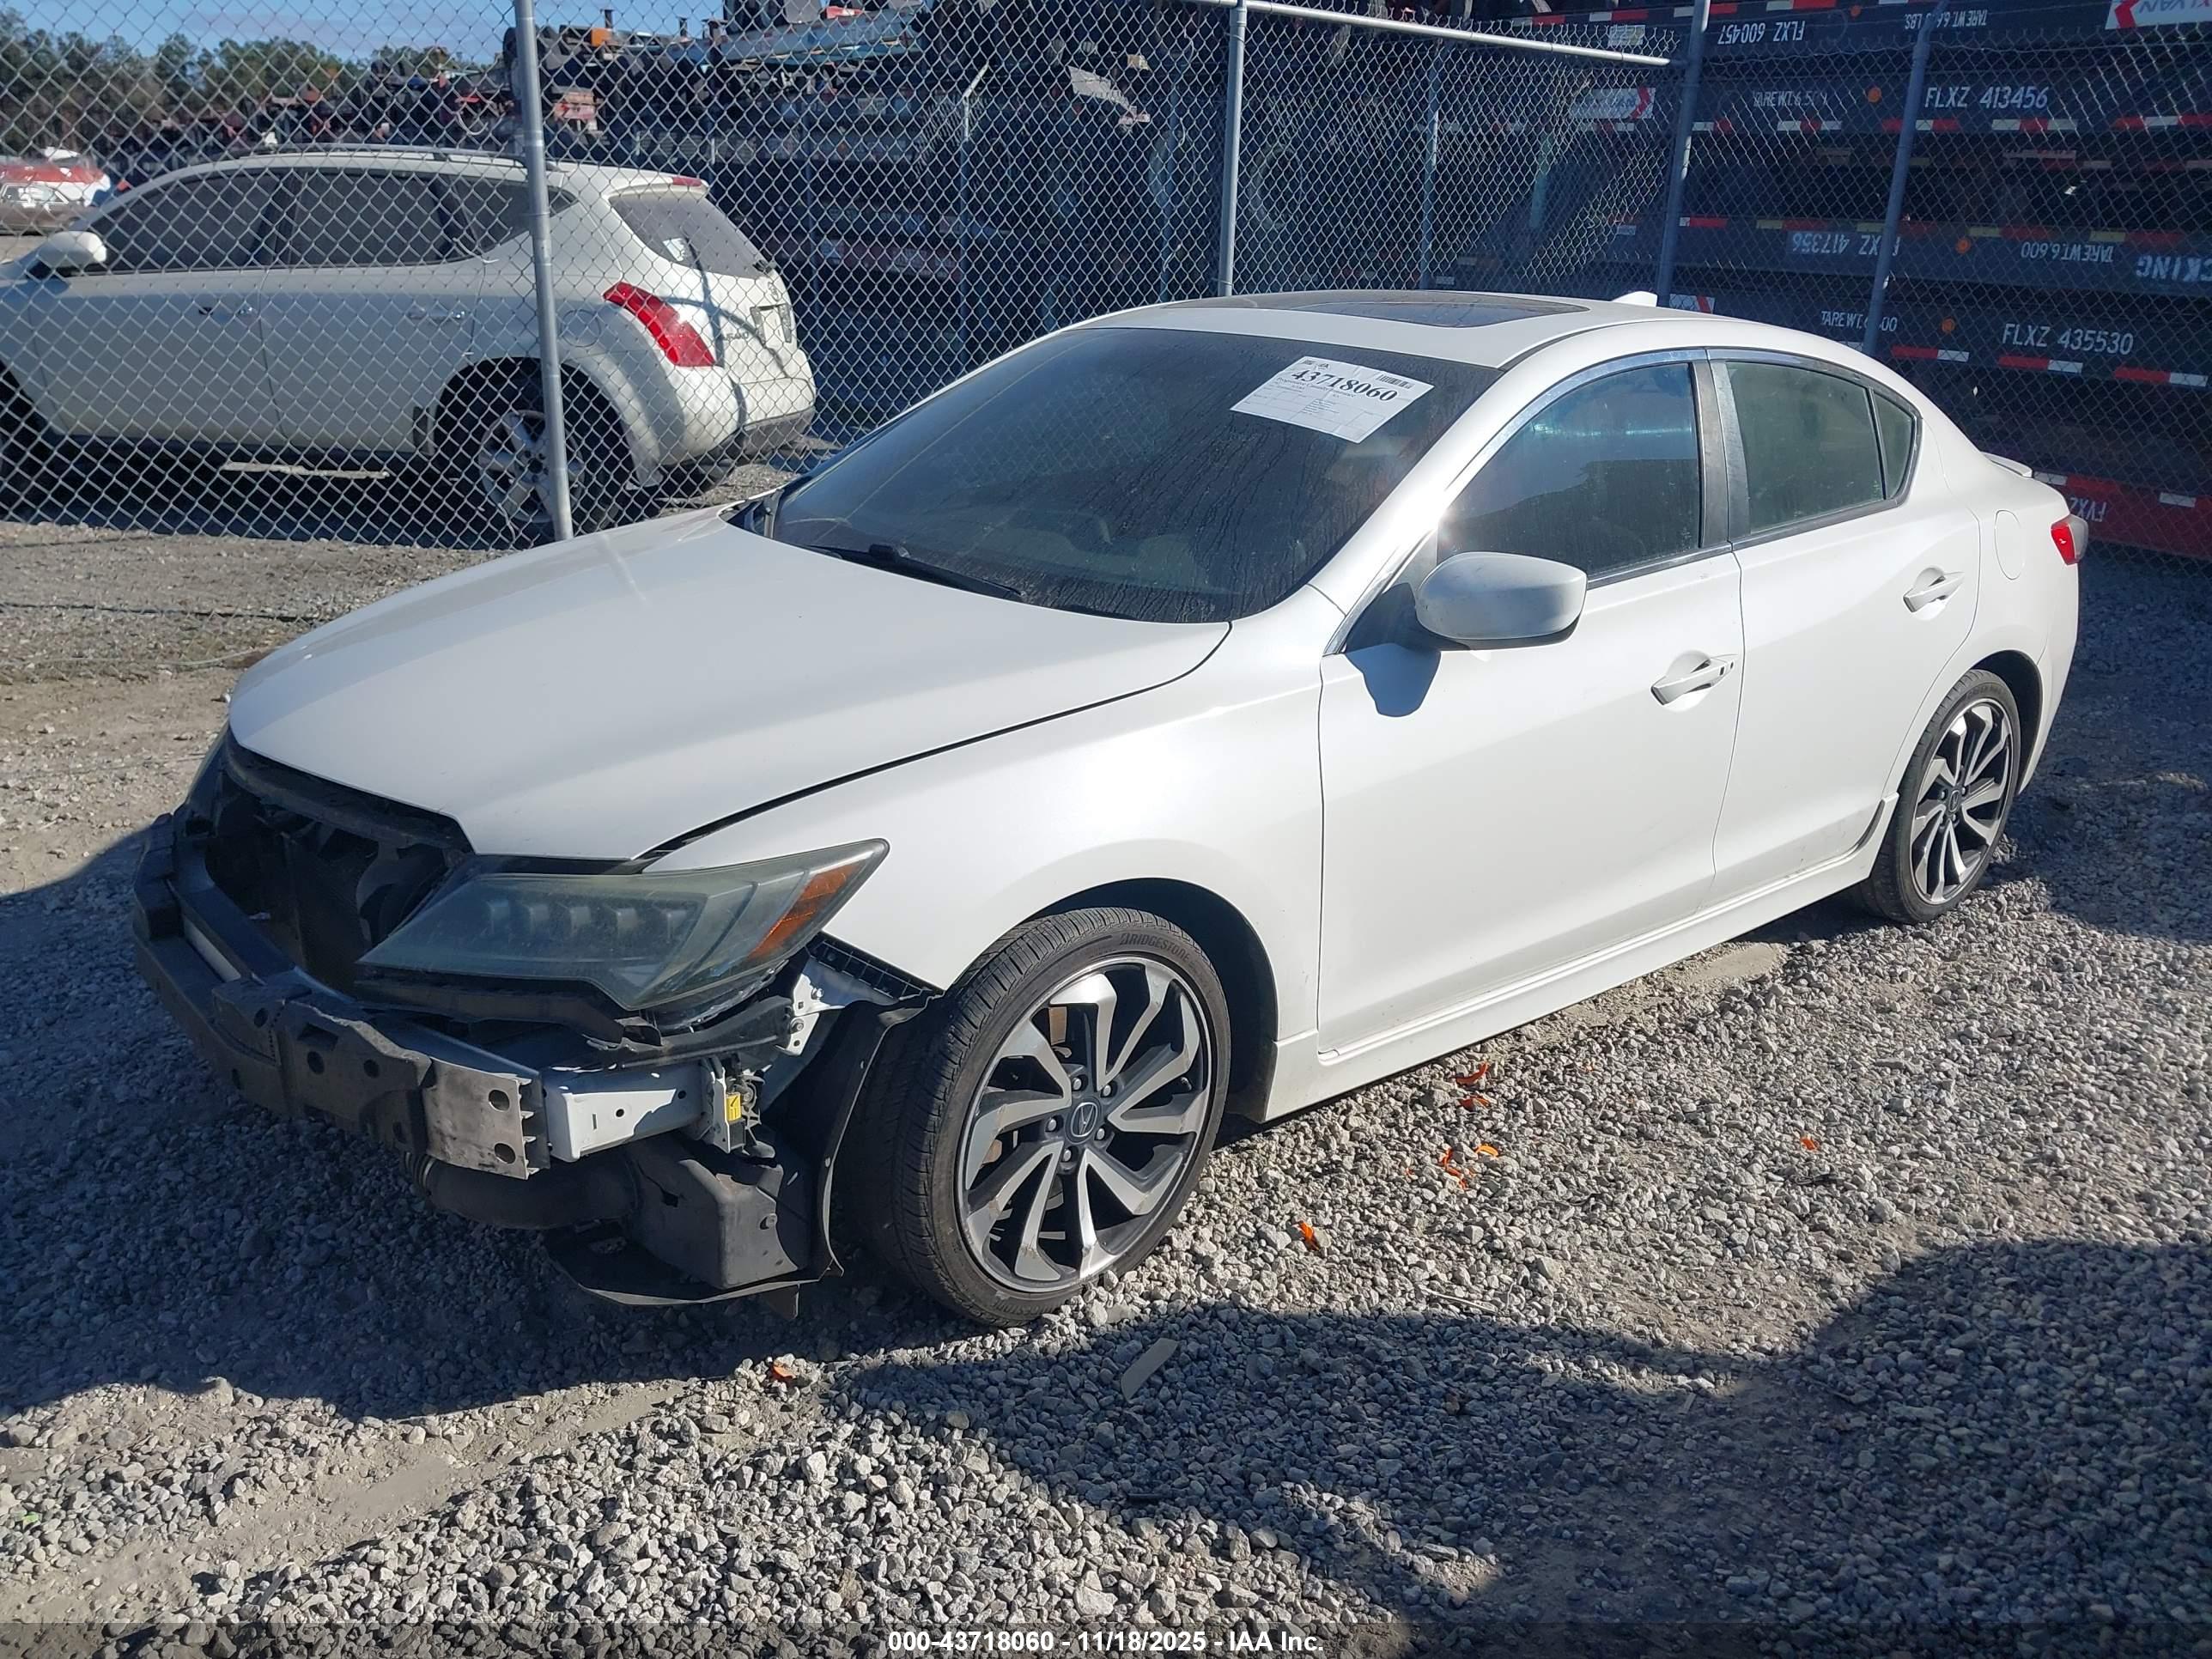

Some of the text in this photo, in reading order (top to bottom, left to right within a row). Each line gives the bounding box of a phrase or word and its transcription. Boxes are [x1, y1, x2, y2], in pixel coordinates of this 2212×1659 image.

[1717, 21, 1805, 45] FLXZ 600457
[1924, 86, 2050, 109] FLXZ 413456
[1792, 232, 1901, 256] FXZ 417356
[2136, 255, 2212, 282] CKING
[2002, 323, 2134, 355] FLXZ 435530
[1291, 369, 1398, 401] 43718060
[1120, 933, 1190, 961] BRIDGESTONE
